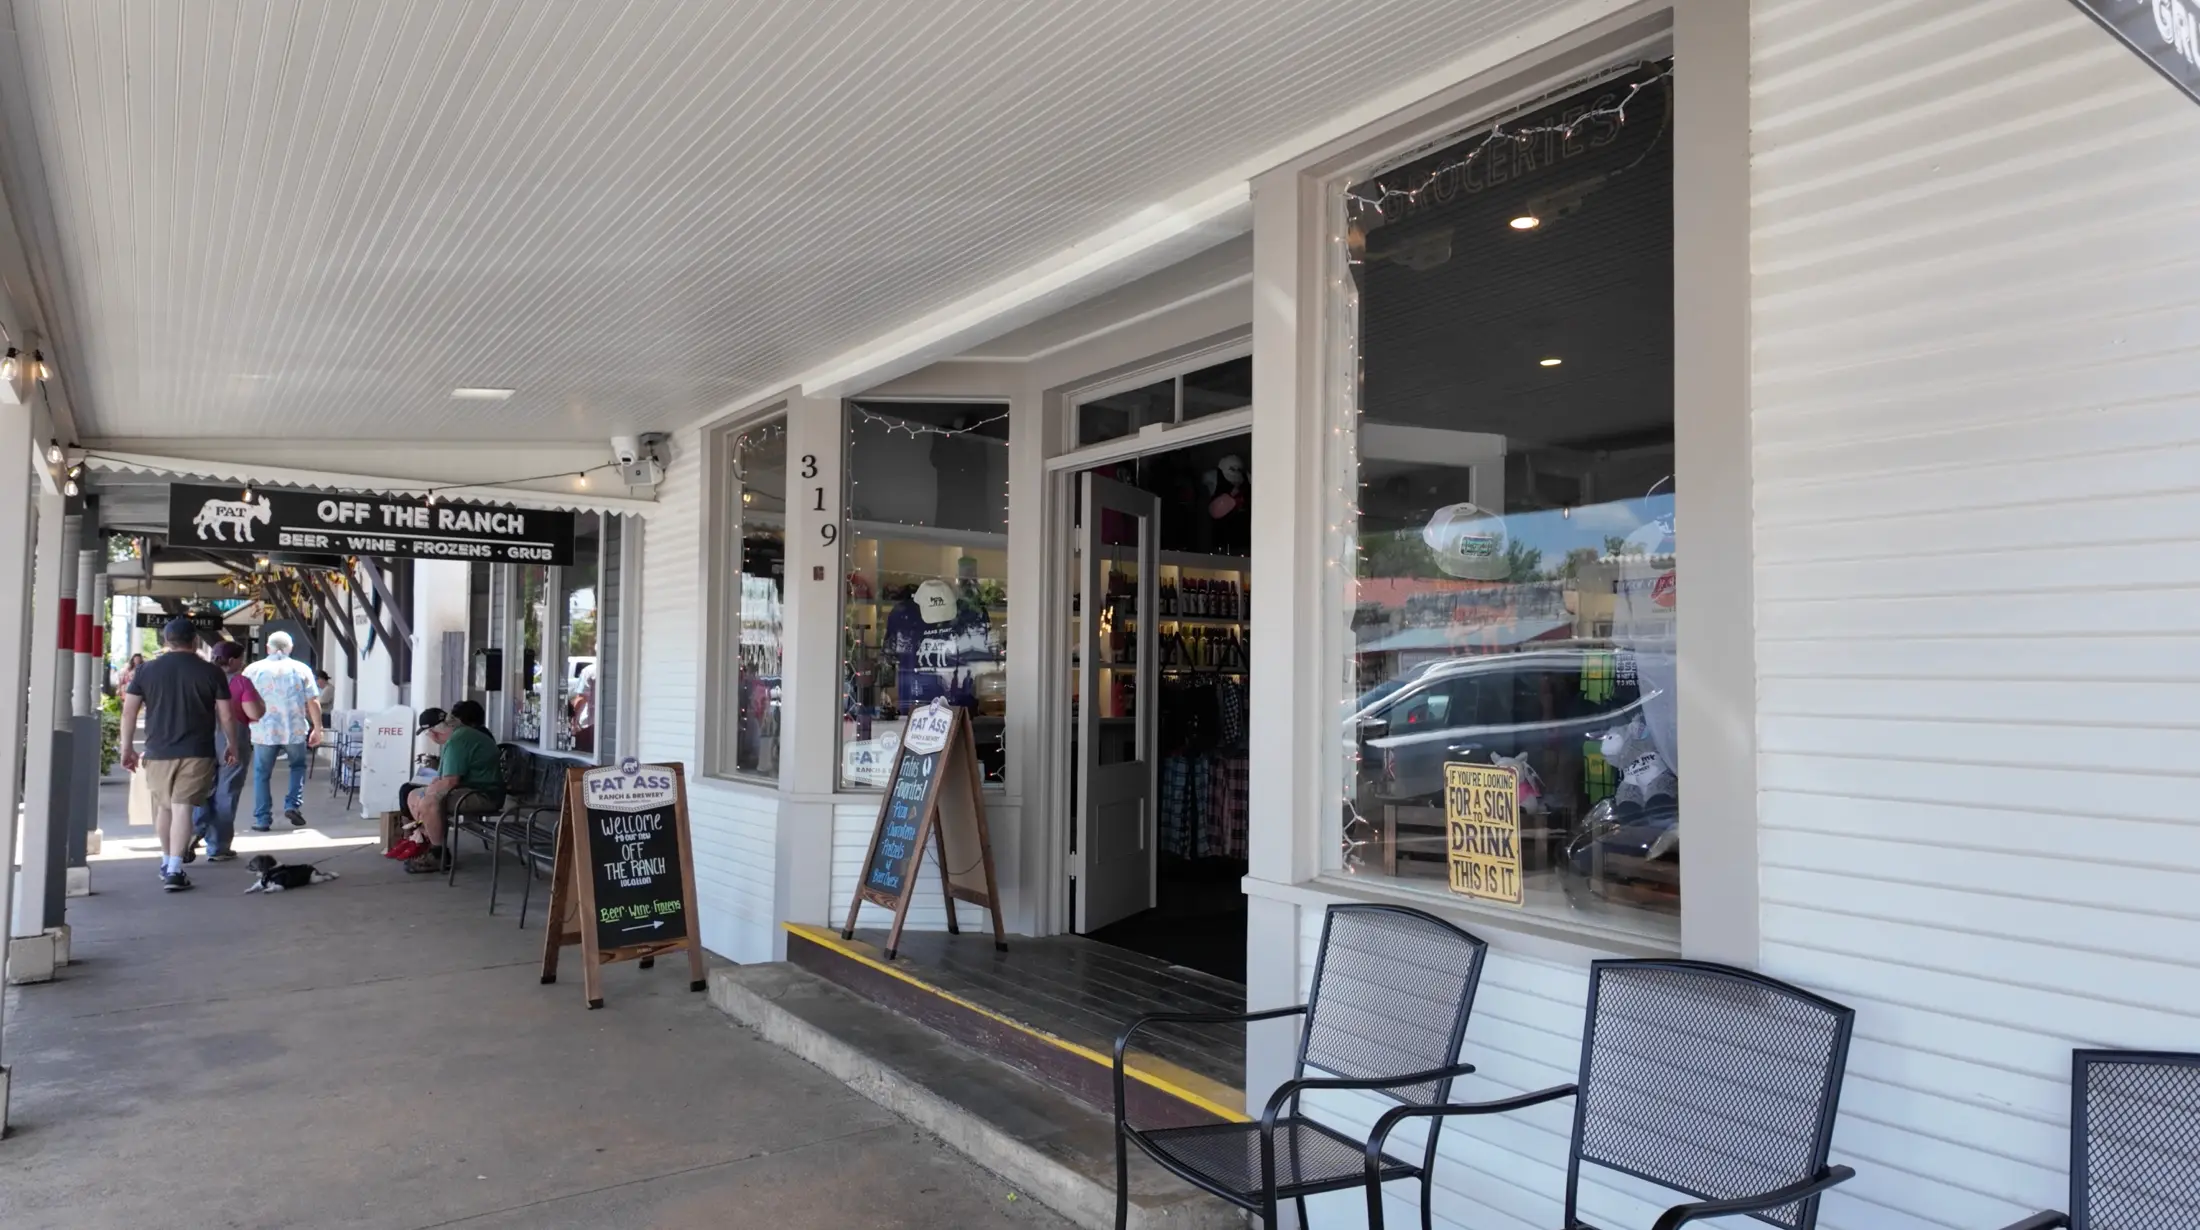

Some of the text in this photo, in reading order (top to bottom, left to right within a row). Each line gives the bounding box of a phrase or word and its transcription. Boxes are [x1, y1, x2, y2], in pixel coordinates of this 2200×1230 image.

[216, 506, 247, 518] FAT
[317, 500, 525, 535] OFF THE RANCH
[278, 533, 553, 560] BEER WINE FROZENS GRUB
[378, 727, 403, 736] FREE
[911, 717, 947, 734] FAT ASS
[849, 750, 883, 766] FAT
[589, 775, 670, 793] FAT ASS
[1450, 770, 1513, 790] IF YOU'RE LOOKING
[599, 792, 624, 800] RANCH
[632, 791, 664, 799] BREWERY
[1449, 787, 1513, 826] FOR A SIGN
[1473, 811, 1483, 823] TO
[625, 833, 637, 841] our
[638, 832, 651, 840] new
[1451, 821, 1515, 859] DRINK
[621, 842, 645, 861] OFF
[604, 857, 666, 880] THE RANCH
[1453, 860, 1482, 890] THIS
[1484, 864, 1498, 893] IS
[620, 876, 652, 888] location
[600, 905, 625, 921] Beer
[629, 903, 651, 917] Wine
